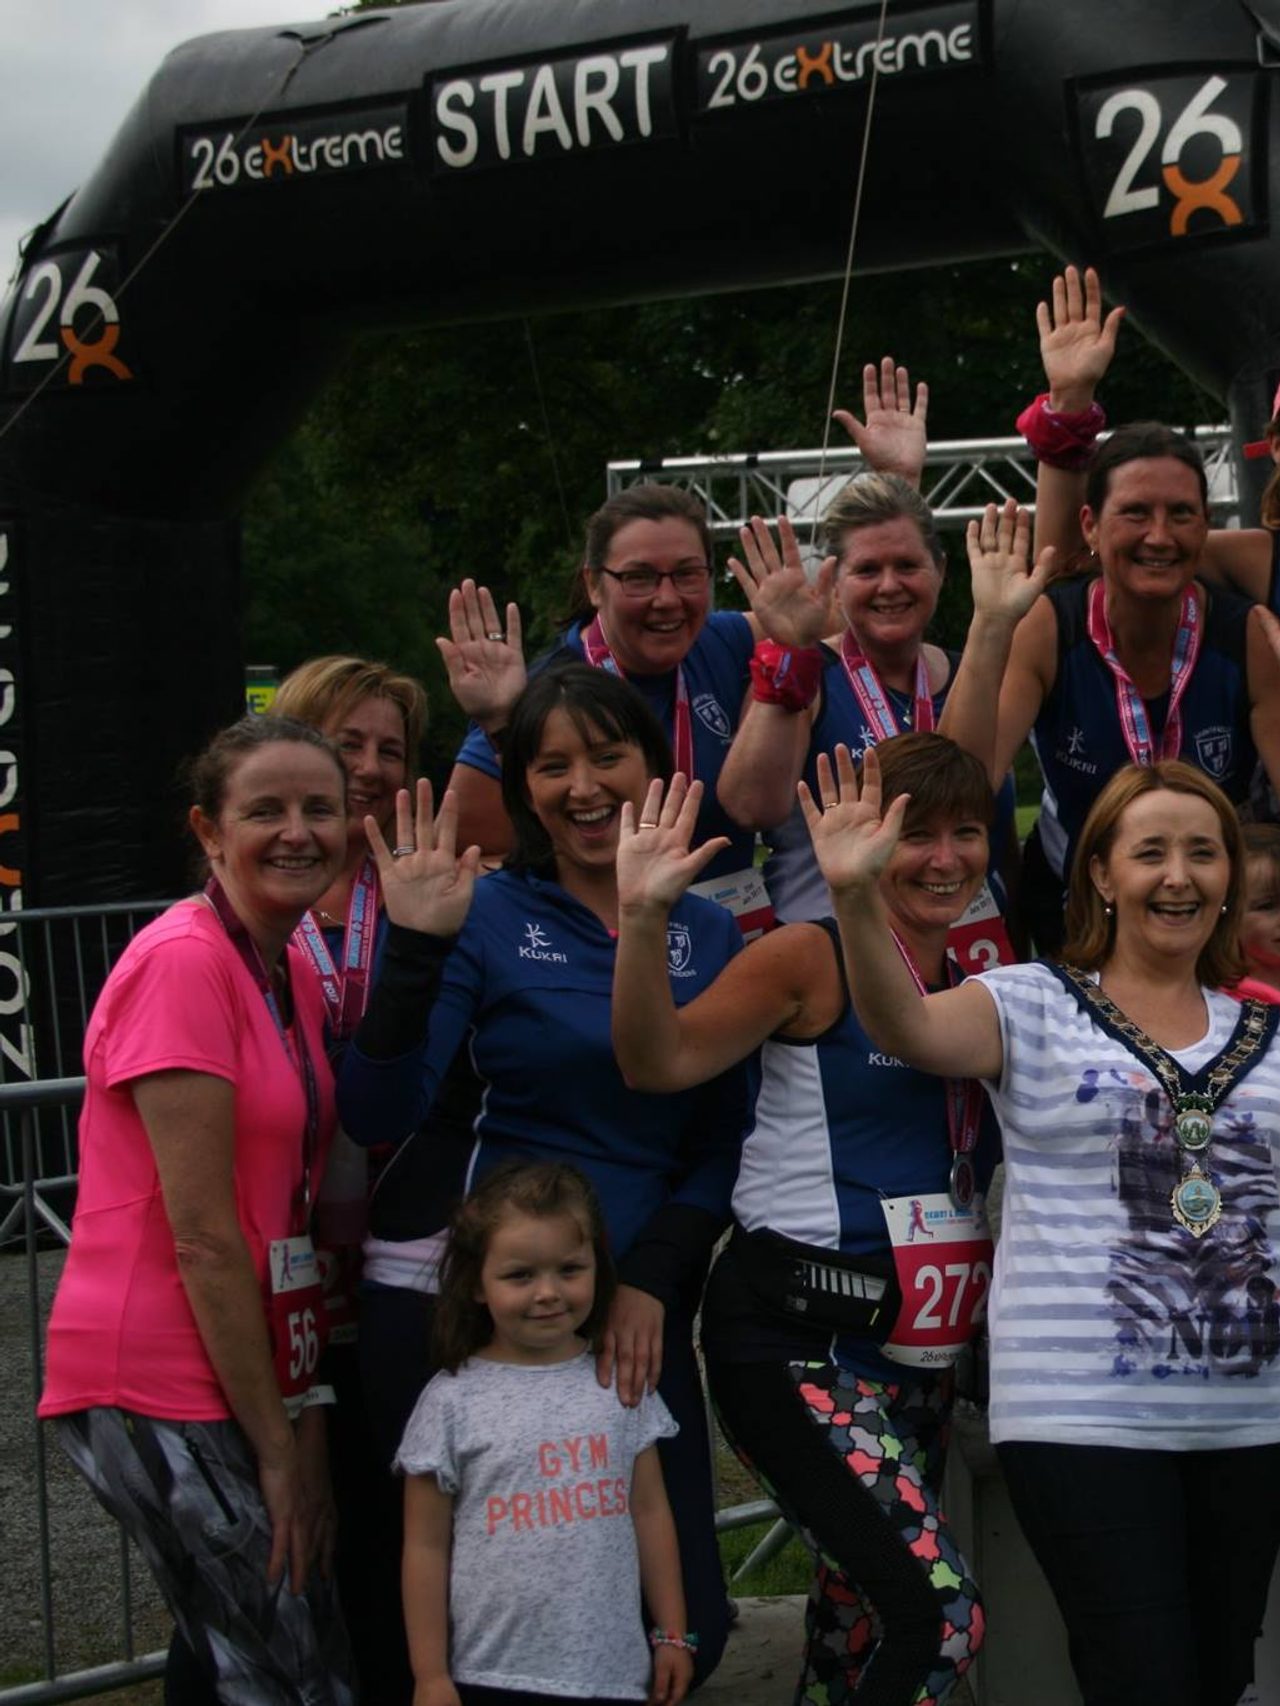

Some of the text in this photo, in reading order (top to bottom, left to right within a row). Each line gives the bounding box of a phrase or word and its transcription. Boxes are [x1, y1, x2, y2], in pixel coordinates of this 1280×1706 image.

[435, 45, 668, 169] START
[519, 946, 567, 964] KUKRI
[912, 1260, 992, 1330] 272
[287, 1307, 320, 1381] 56
[538, 1432, 609, 1479] GYM
